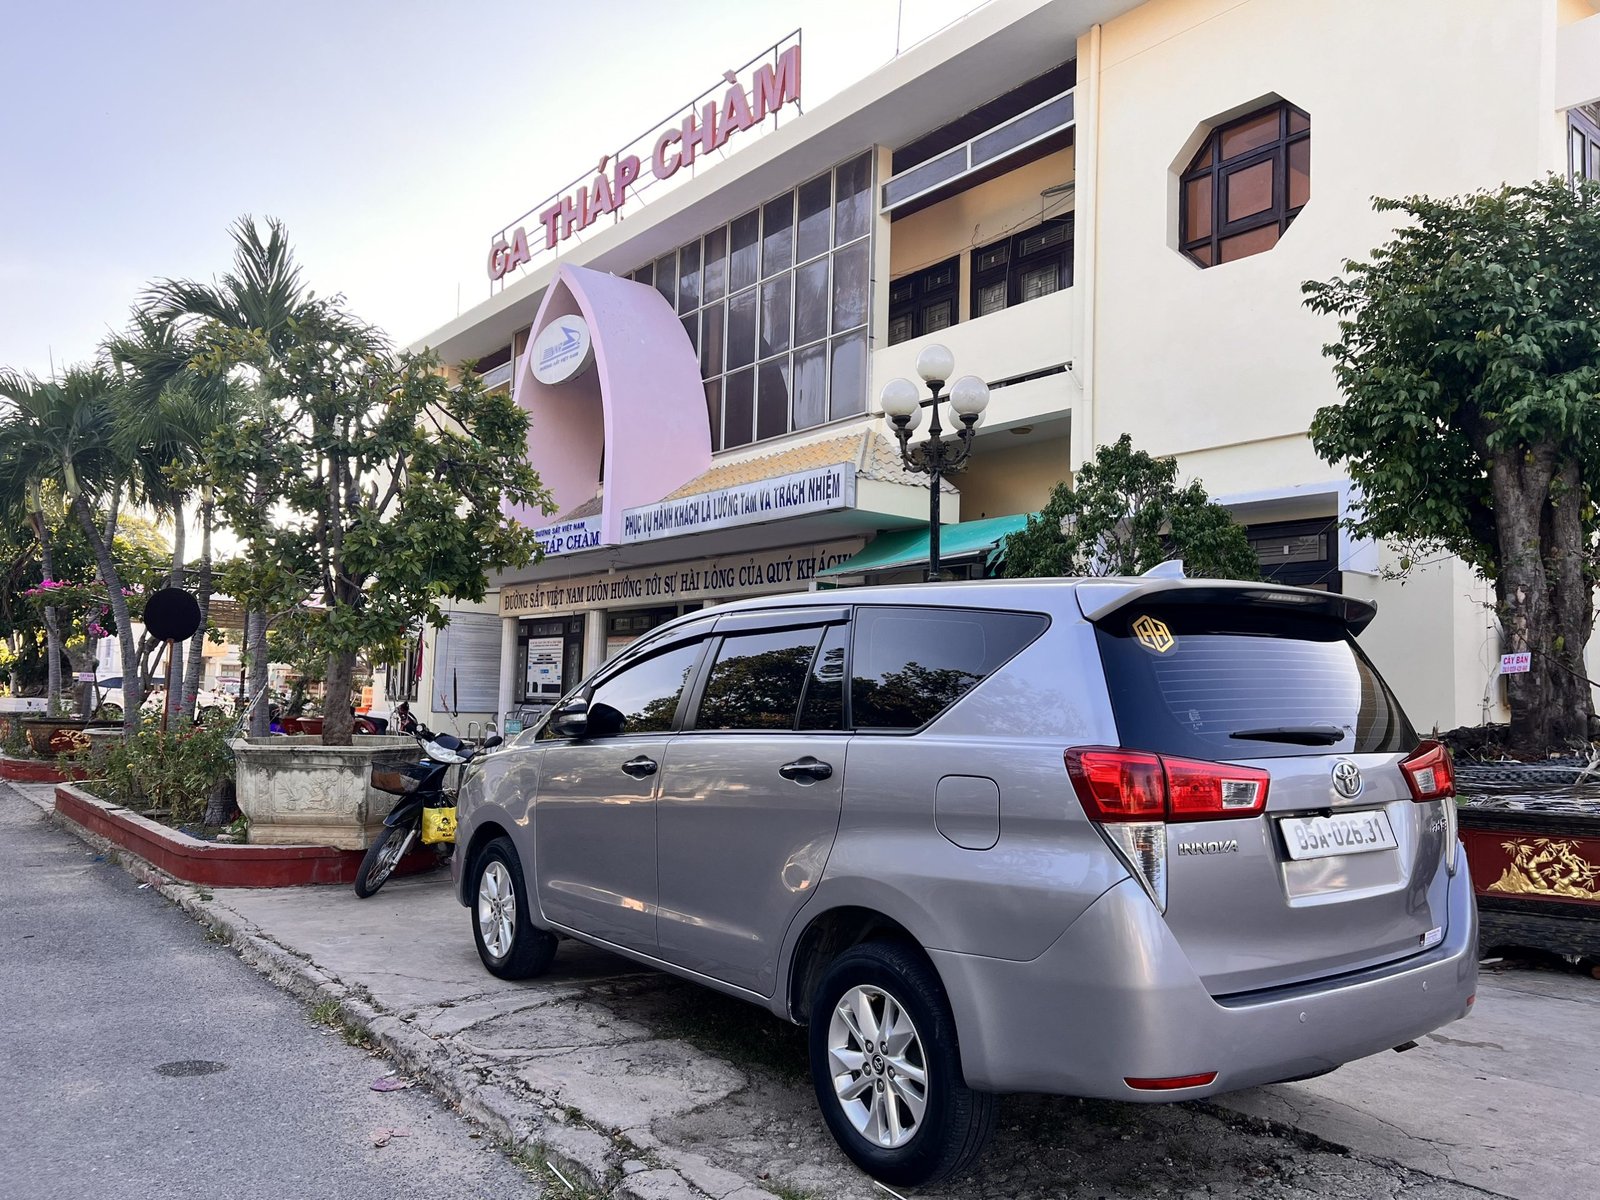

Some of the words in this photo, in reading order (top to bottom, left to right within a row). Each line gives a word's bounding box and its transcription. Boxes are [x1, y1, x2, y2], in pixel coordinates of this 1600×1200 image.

[487, 226, 531, 281] GA
[539, 155, 640, 250] THÁP
[652, 44, 801, 180] CHÀM
[625, 514, 641, 539] PHỤC
[643, 511, 652, 537] VỤ
[653, 505, 673, 531] HÀNH
[674, 500, 699, 527] KHÁCH
[701, 494, 711, 522] LÀ
[774, 477, 806, 508] TRÁCH
[808, 469, 840, 505] NHIỆM
[566, 528, 601, 550] CHÀM
[573, 521, 585, 530] NAM
[504, 589, 528, 610] ĐƯỜNG
[530, 585, 545, 608] SẮT
[547, 586, 564, 609] VIỆT
[566, 586, 584, 605] NAM
[586, 580, 609, 602] LUÔN
[610, 575, 642, 599] HƯỚNG
[664, 571, 678, 597] SỰ
[680, 568, 700, 592] HÀI
[704, 564, 735, 589] LÒNG
[739, 558, 763, 586] CỦA
[766, 554, 793, 583] QUÝ
[1178, 840, 1239, 856] INNOVA
